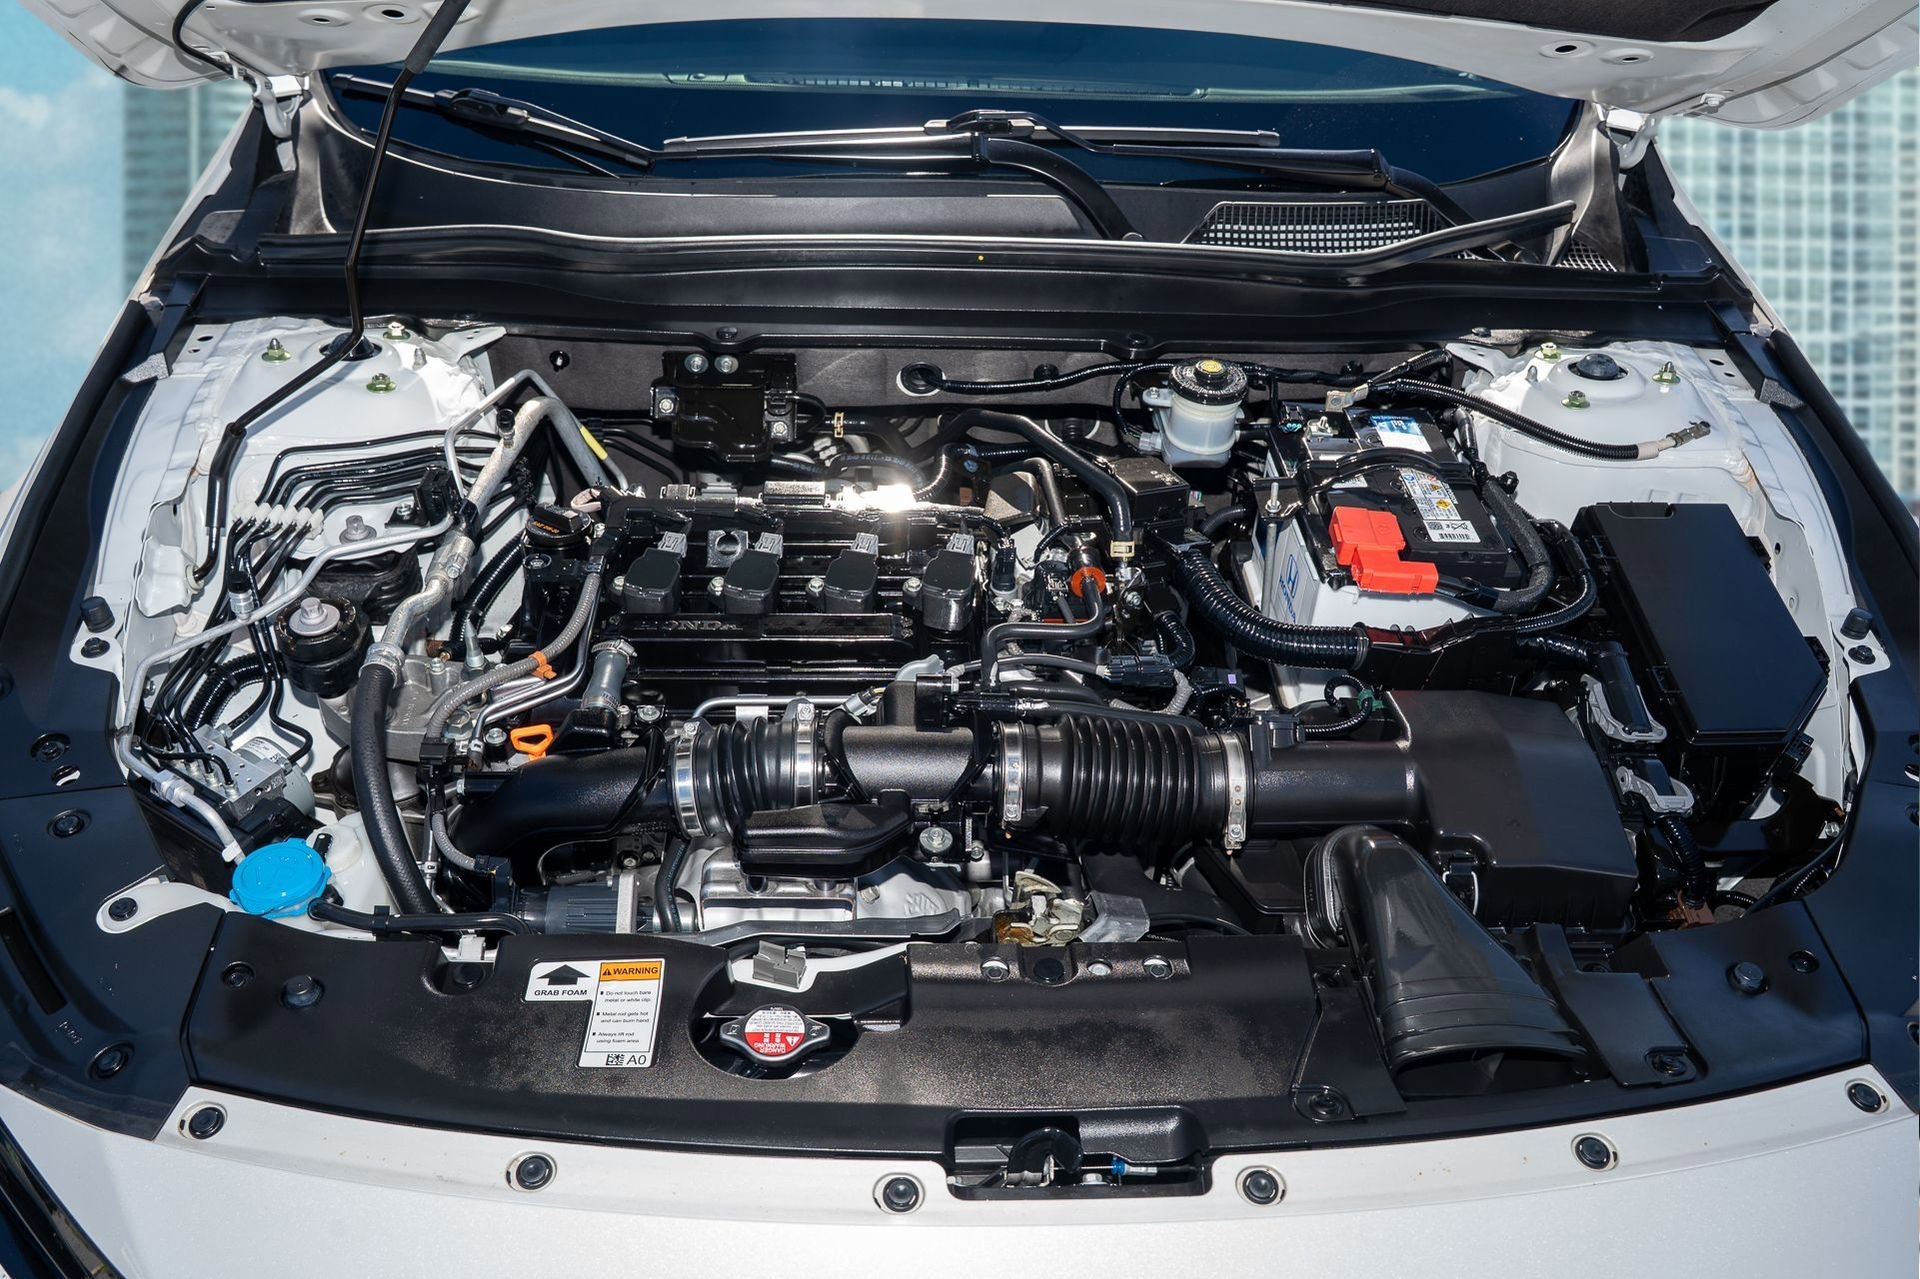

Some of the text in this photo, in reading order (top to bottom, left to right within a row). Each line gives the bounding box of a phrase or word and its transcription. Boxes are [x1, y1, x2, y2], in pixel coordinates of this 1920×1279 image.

[1279, 575, 1297, 623] HONDA
[613, 966, 659, 975] WARNING
[626, 1055, 647, 1065] A0
